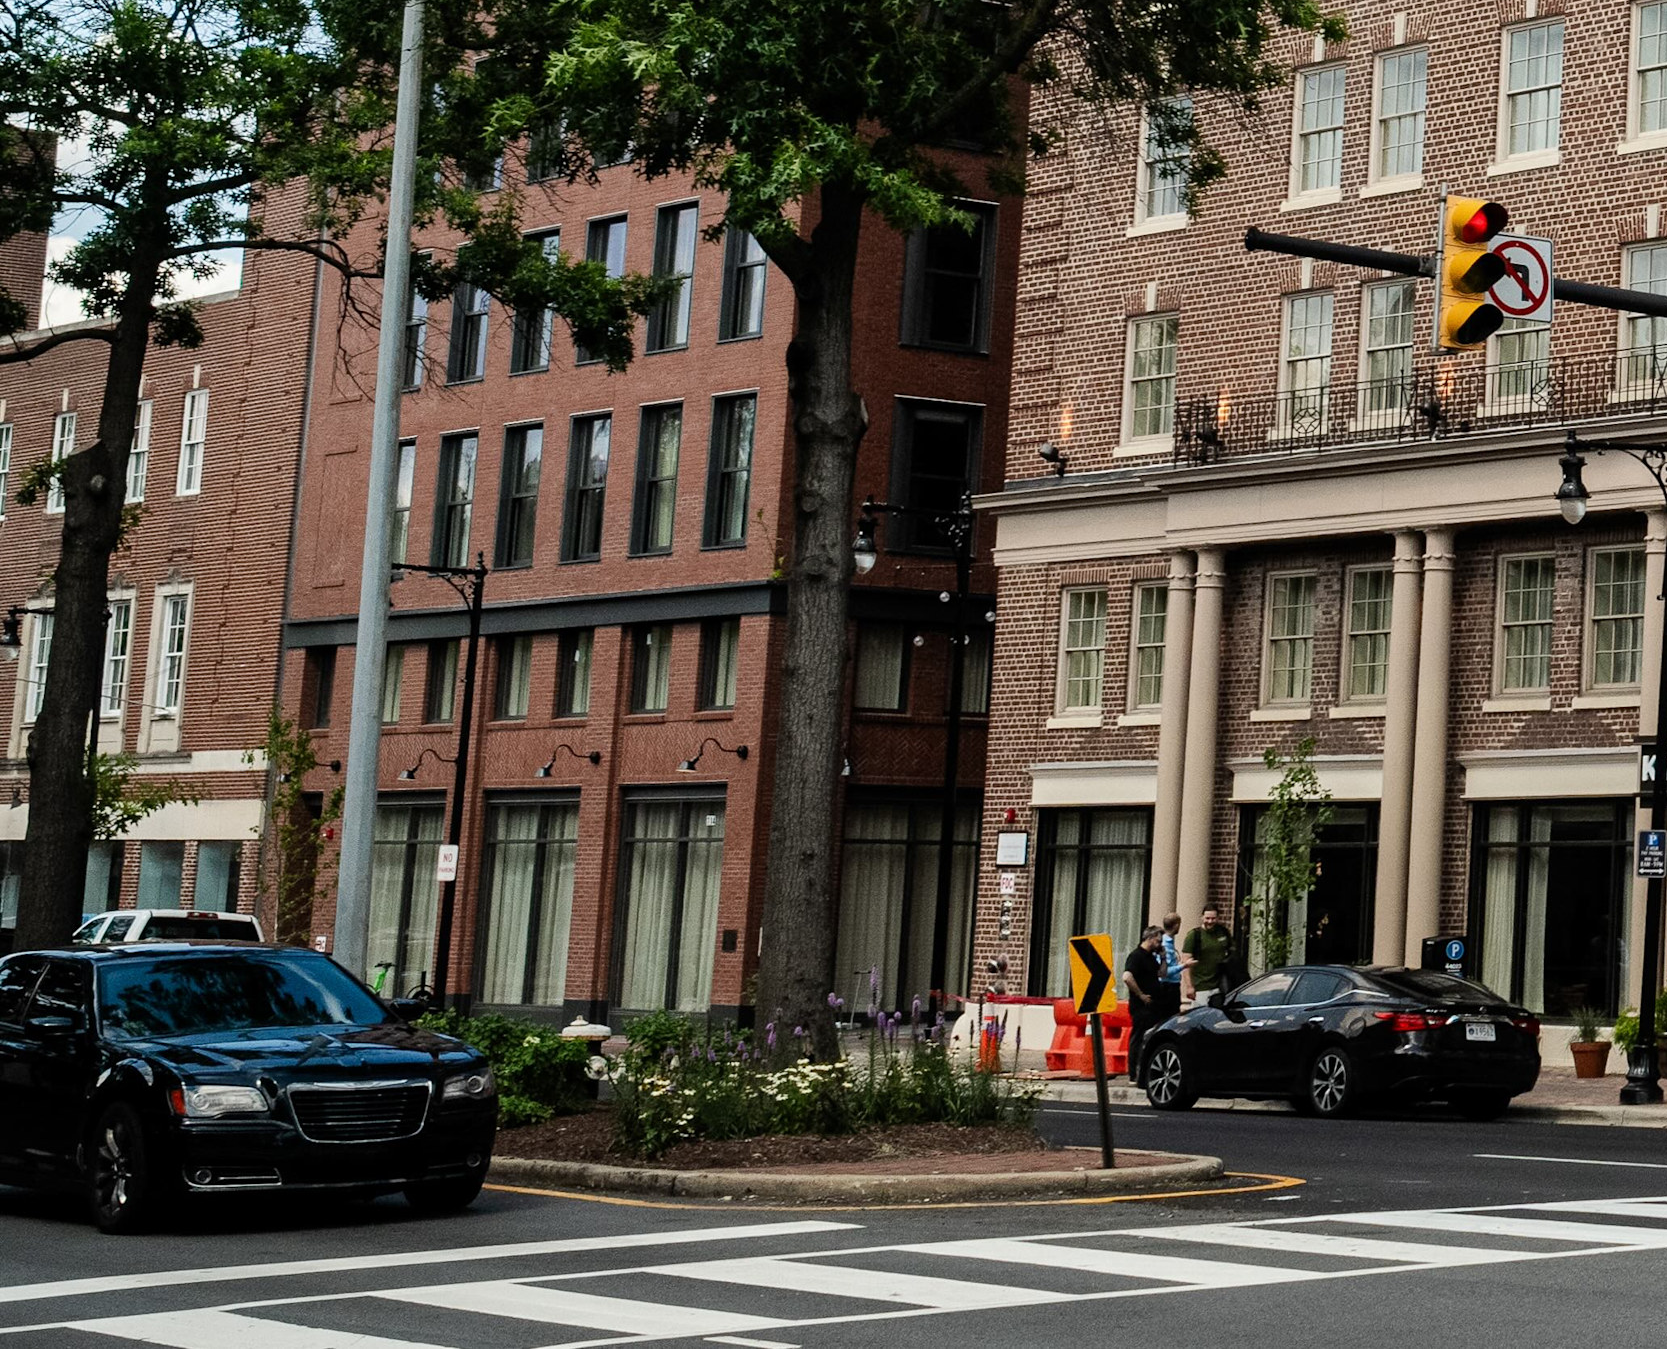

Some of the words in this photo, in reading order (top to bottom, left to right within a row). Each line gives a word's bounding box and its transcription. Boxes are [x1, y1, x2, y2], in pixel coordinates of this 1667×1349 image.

[1648, 834, 1658, 846] P
[443, 853, 453, 862] NO
[1451, 943, 1460, 957] P
